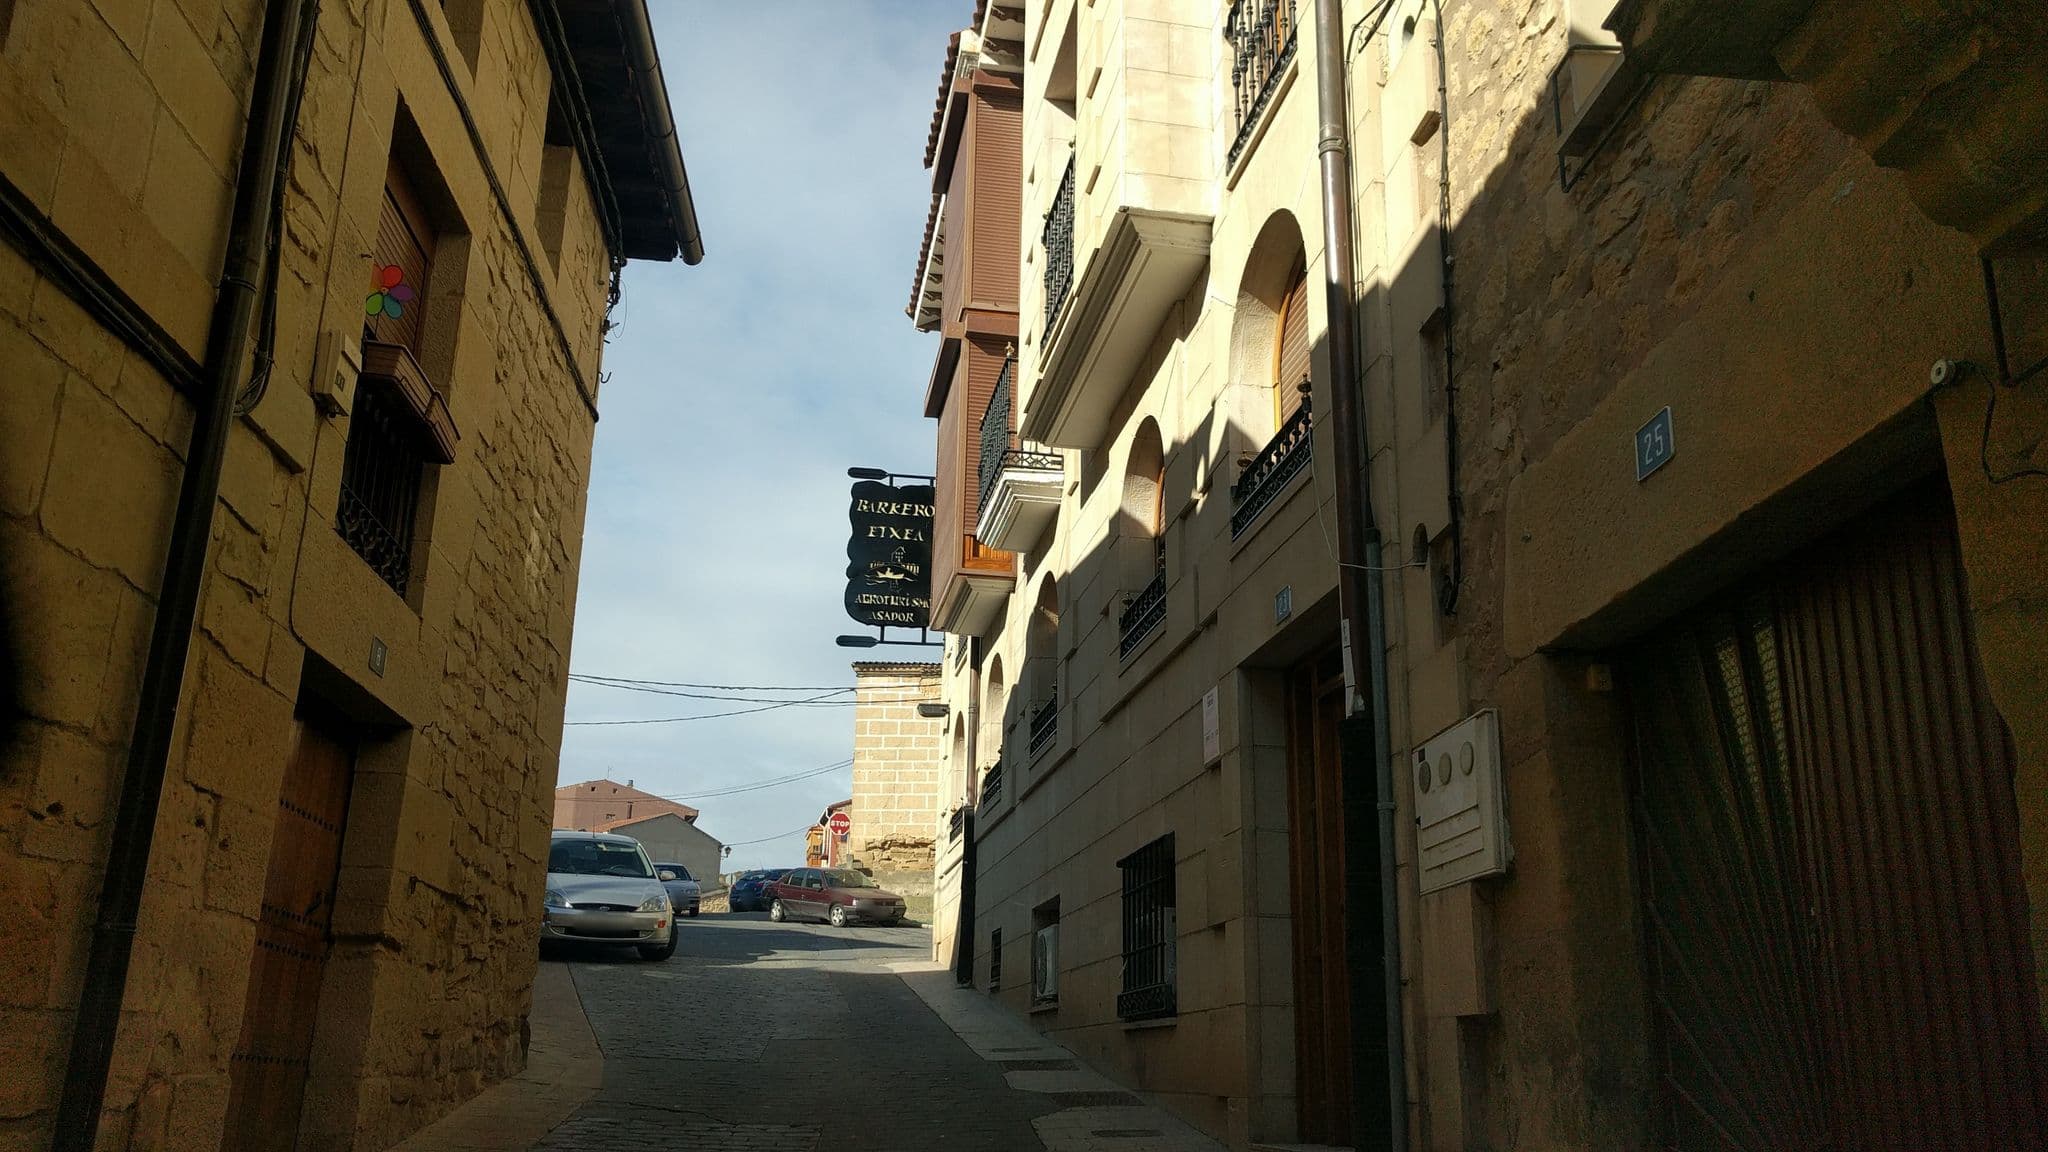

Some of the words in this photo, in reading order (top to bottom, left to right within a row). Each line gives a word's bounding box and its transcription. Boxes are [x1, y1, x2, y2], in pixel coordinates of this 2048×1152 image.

[1644, 423, 1664, 465] 25
[856, 499, 935, 518] BARKERO
[867, 526, 925, 542] ETXEA
[869, 611, 914, 622] ASADOR
[830, 820, 850, 828] STOP
